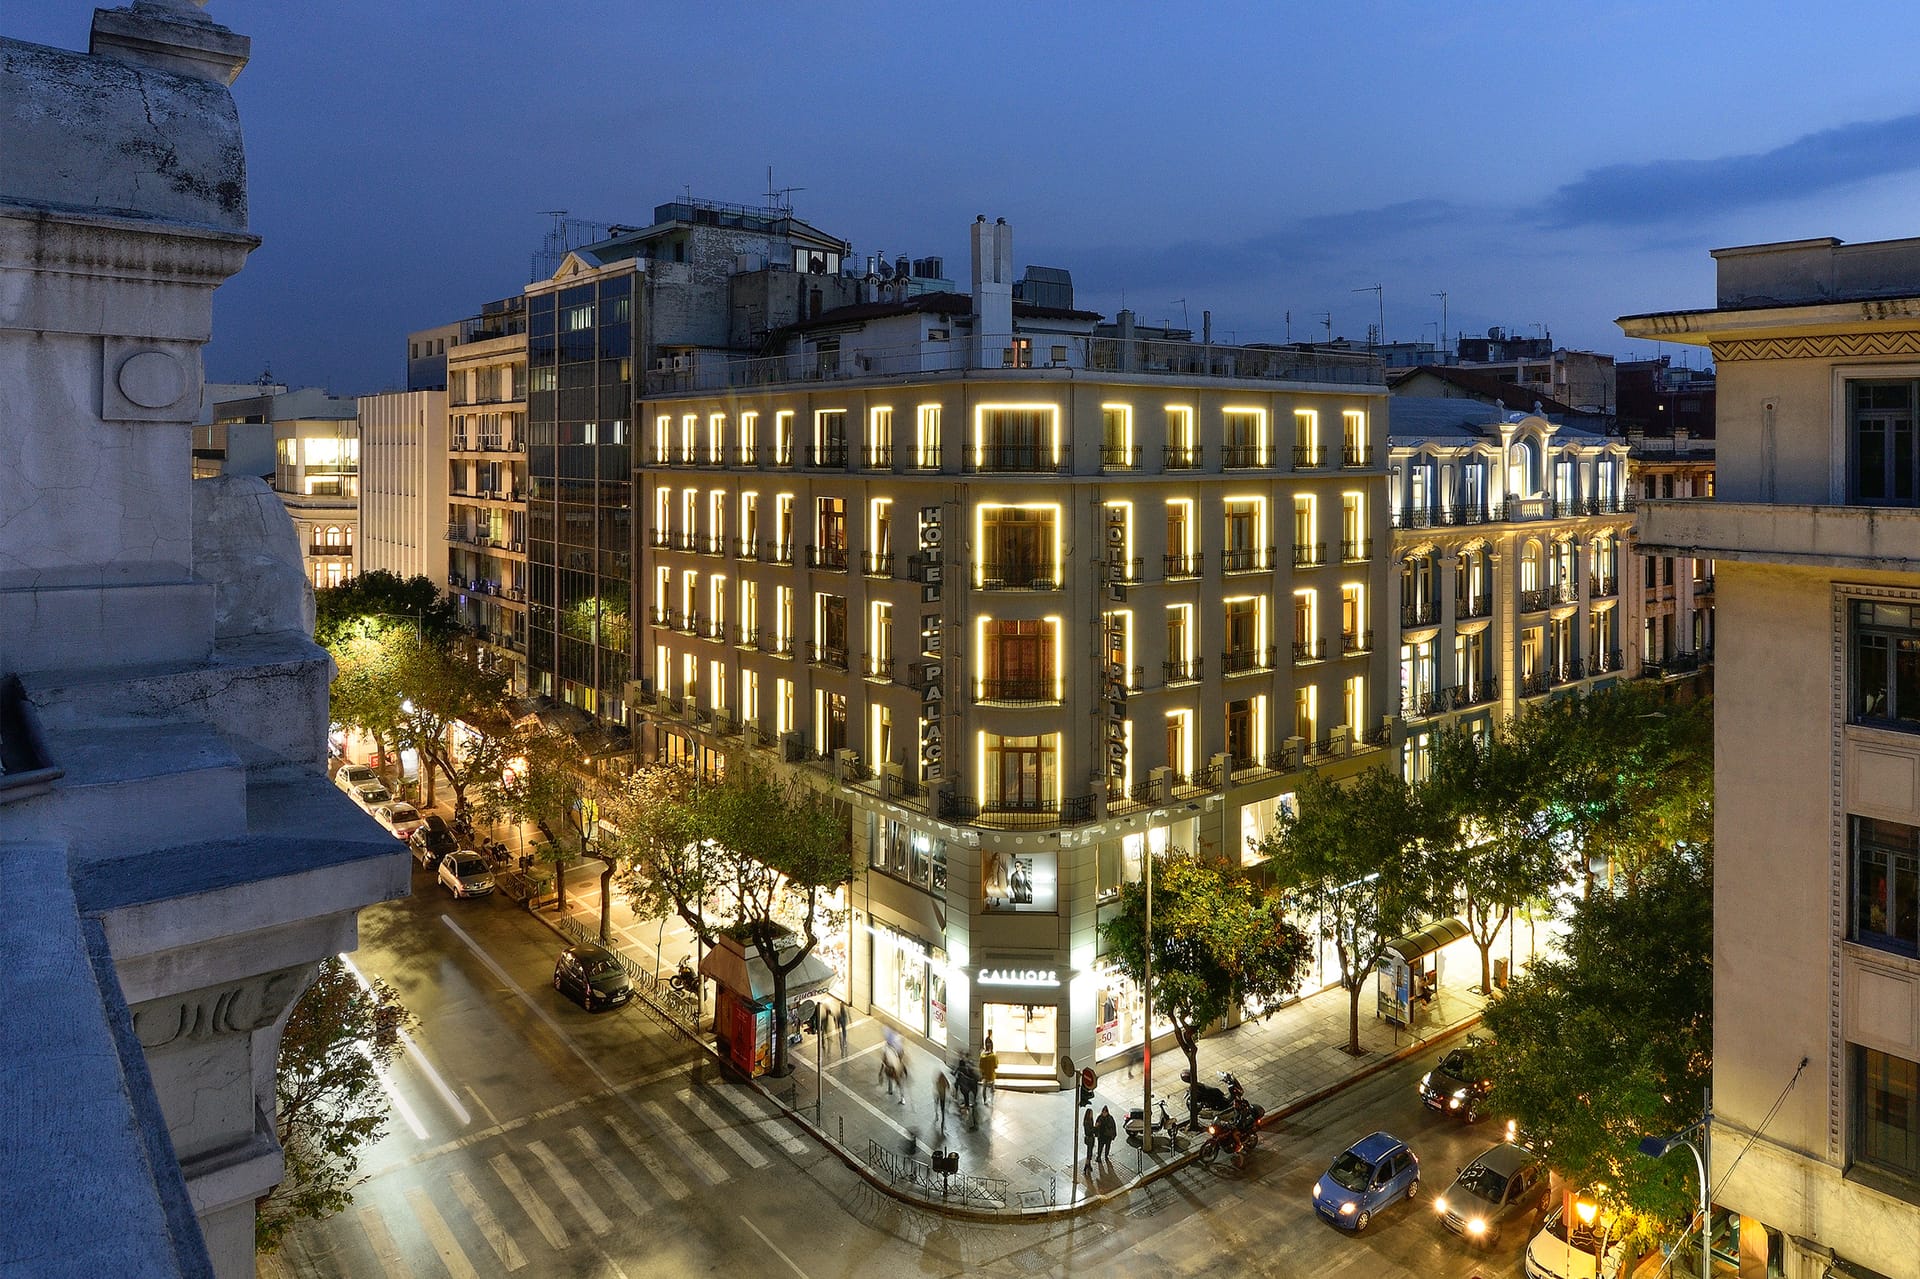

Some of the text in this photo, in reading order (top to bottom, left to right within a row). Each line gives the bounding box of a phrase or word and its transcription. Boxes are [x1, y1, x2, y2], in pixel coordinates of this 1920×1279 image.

[926, 508, 942, 779] HOTEL LE PALACE
[1109, 507, 1122, 777] HOTEL LE PALACE
[978, 968, 1057, 982] CALLIOPE
